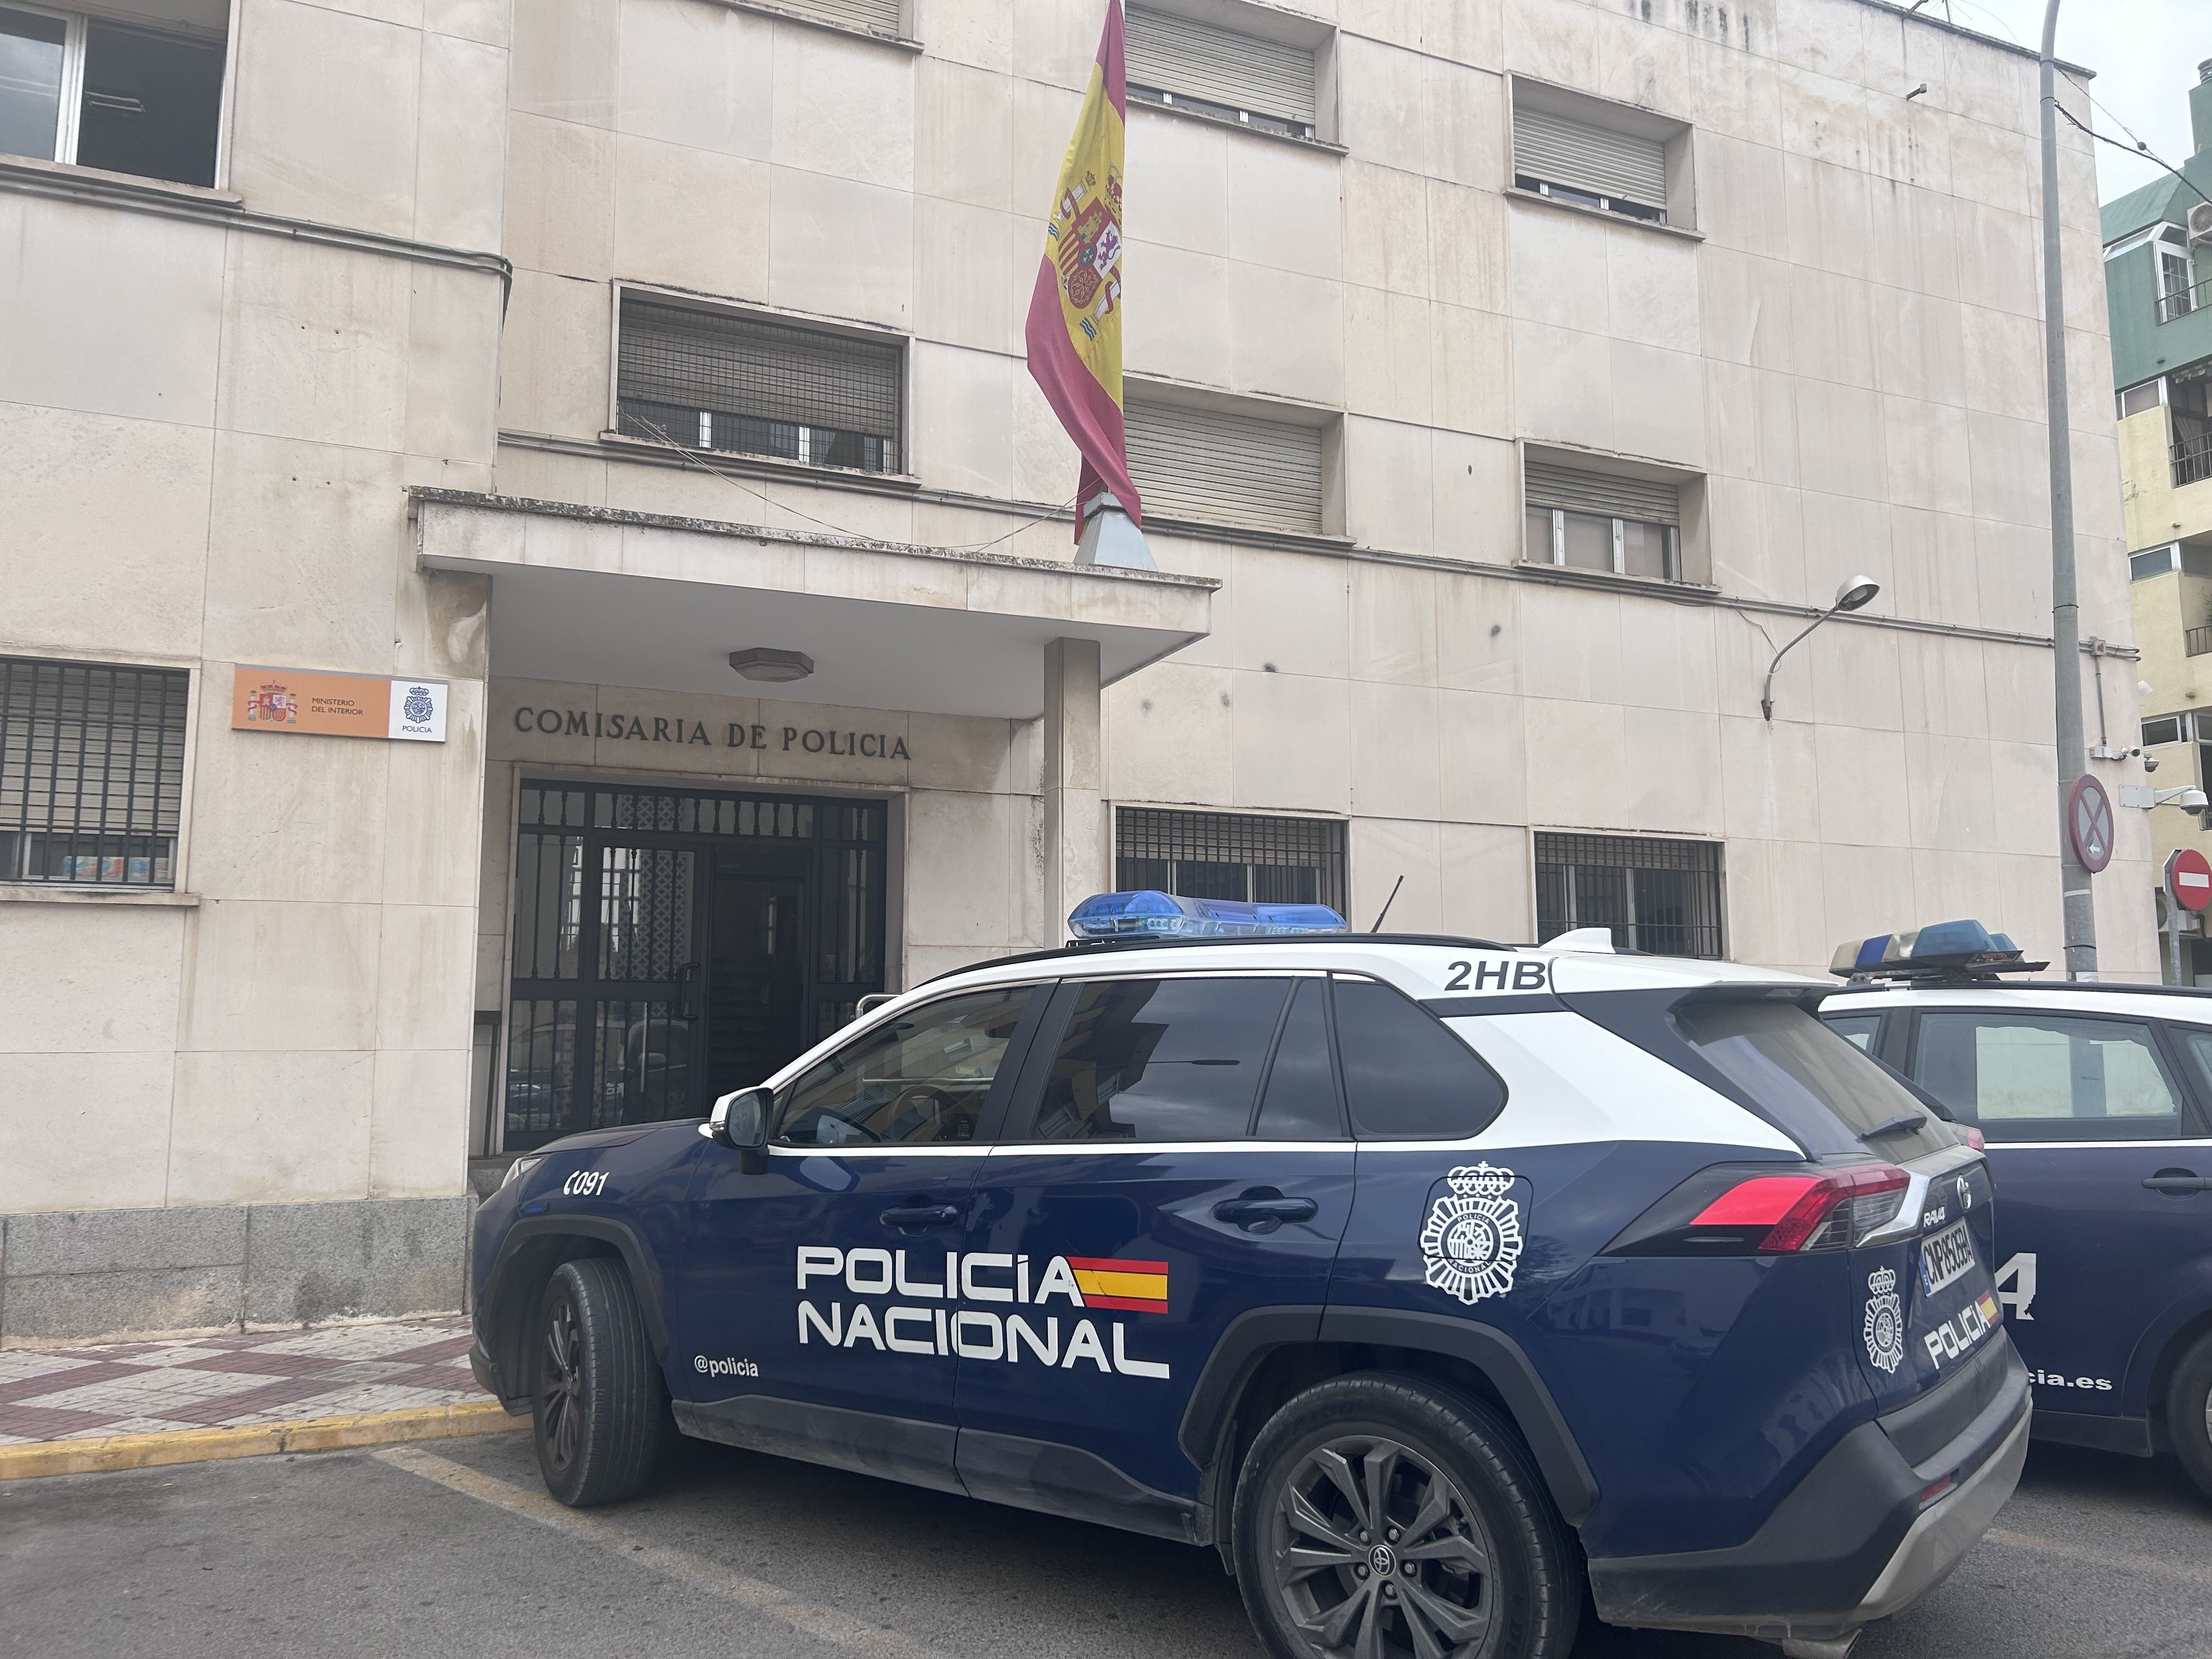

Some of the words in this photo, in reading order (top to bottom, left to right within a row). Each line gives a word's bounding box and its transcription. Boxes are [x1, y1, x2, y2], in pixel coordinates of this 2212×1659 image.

[312, 697, 354, 707] MINISTERIO
[328, 707, 363, 715] INTERIOR
[515, 707, 712, 746] COMISARIA
[727, 723, 767, 749] DE
[782, 727, 911, 760] POLICIA
[1444, 961, 1546, 991] 2HB
[1457, 1214, 1490, 1224] POLICIA
[1923, 1206, 1945, 1227] RAV4
[1448, 1259, 1491, 1273] NACIONAL
[798, 1300, 1170, 1380] NACIONAL
[694, 1355, 759, 1378] @policia
